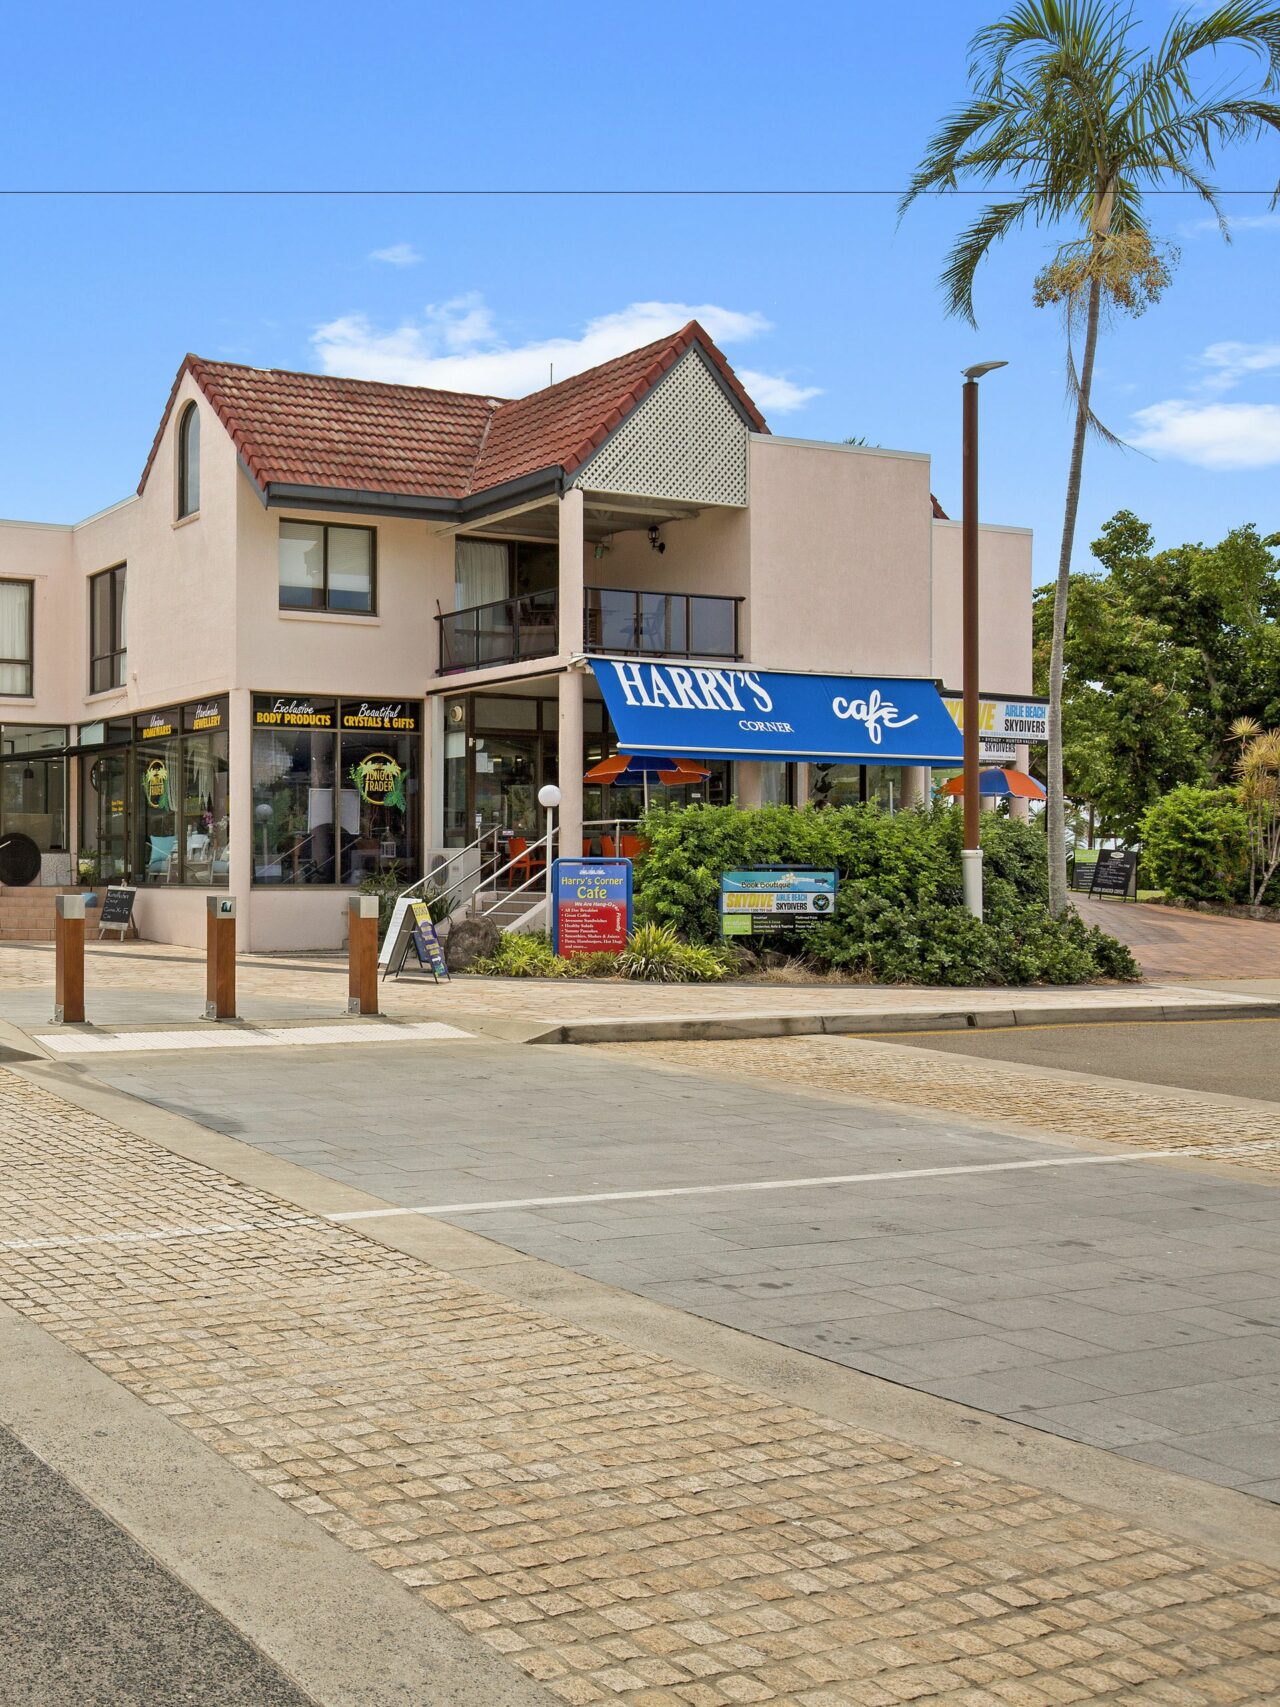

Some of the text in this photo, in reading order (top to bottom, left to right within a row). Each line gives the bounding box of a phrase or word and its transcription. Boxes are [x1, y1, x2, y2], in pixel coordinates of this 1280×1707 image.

[611, 661, 773, 712] HARRY'S
[273, 699, 315, 714] Exclusive
[358, 703, 402, 720] Beautiful
[1005, 704, 1046, 718] AIRLIE BEACH
[193, 715, 221, 730] JEWELLERY
[256, 712, 331, 726] BODY PRODUCTS
[343, 716, 415, 729] CRYSTALS & GIFTS
[1004, 719, 1046, 733] SKYDIVERS
[738, 720, 795, 733] CORNER
[365, 780, 393, 792] TRADER
[561, 876, 624, 886] Harry's Corner
[577, 886, 608, 899] Cafe
[726, 893, 774, 908] SKYDIVE
[776, 902, 808, 911] SKYDIVERS
